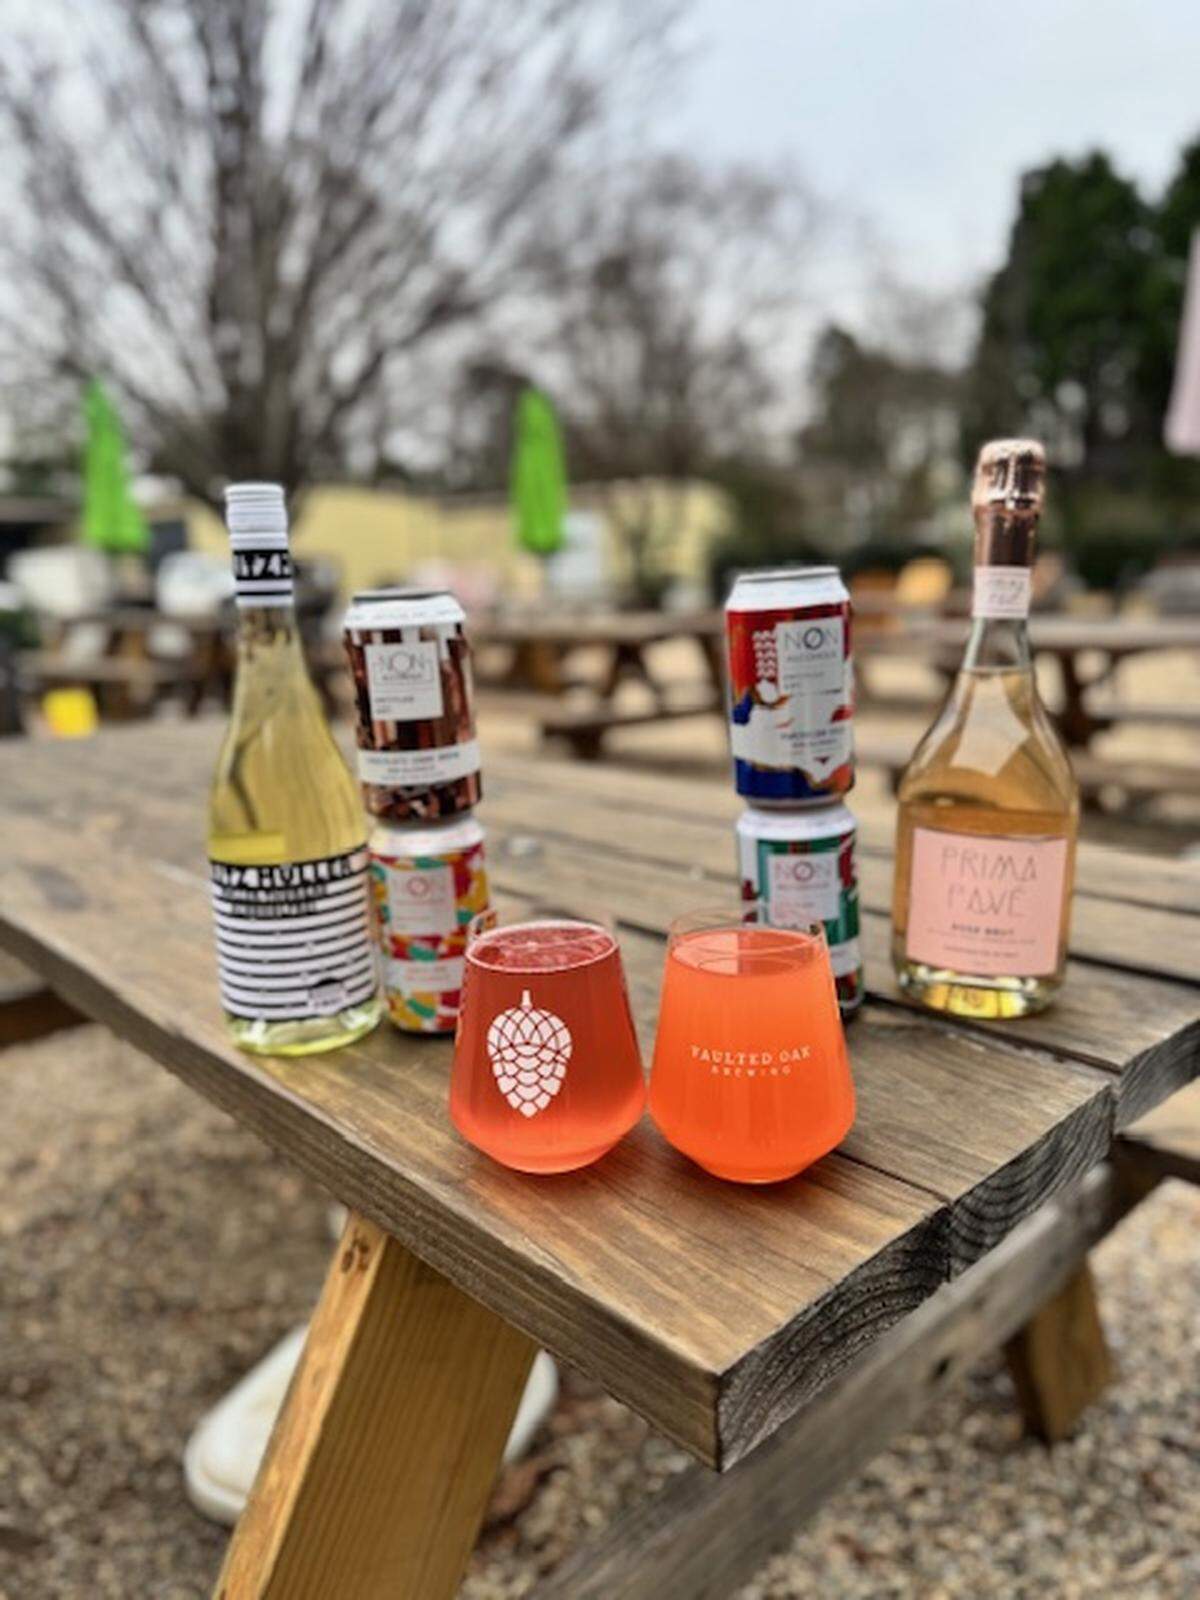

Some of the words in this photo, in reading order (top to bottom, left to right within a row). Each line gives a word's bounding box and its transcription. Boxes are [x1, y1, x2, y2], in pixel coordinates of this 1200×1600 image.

[939, 846, 1038, 882] PRIMA
[690, 1044, 773, 1066] VAULTED
[779, 1046, 811, 1064] OAK
